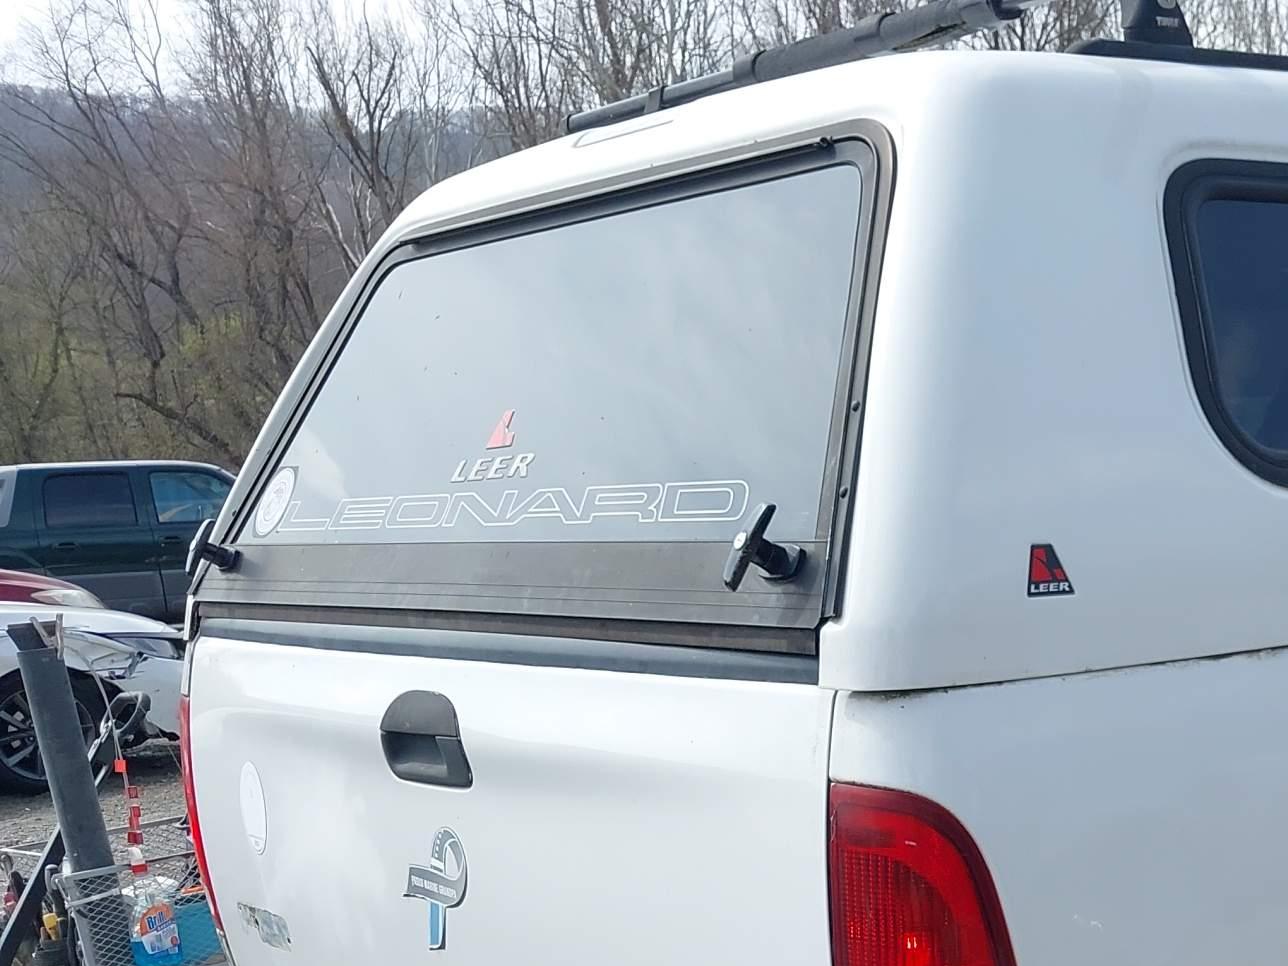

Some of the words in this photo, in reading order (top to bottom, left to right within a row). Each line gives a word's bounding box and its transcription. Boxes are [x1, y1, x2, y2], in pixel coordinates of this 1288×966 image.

[450, 453, 535, 483] LEER
[277, 480, 750, 531] LEONARD
[1030, 582, 1070, 593] LEER
